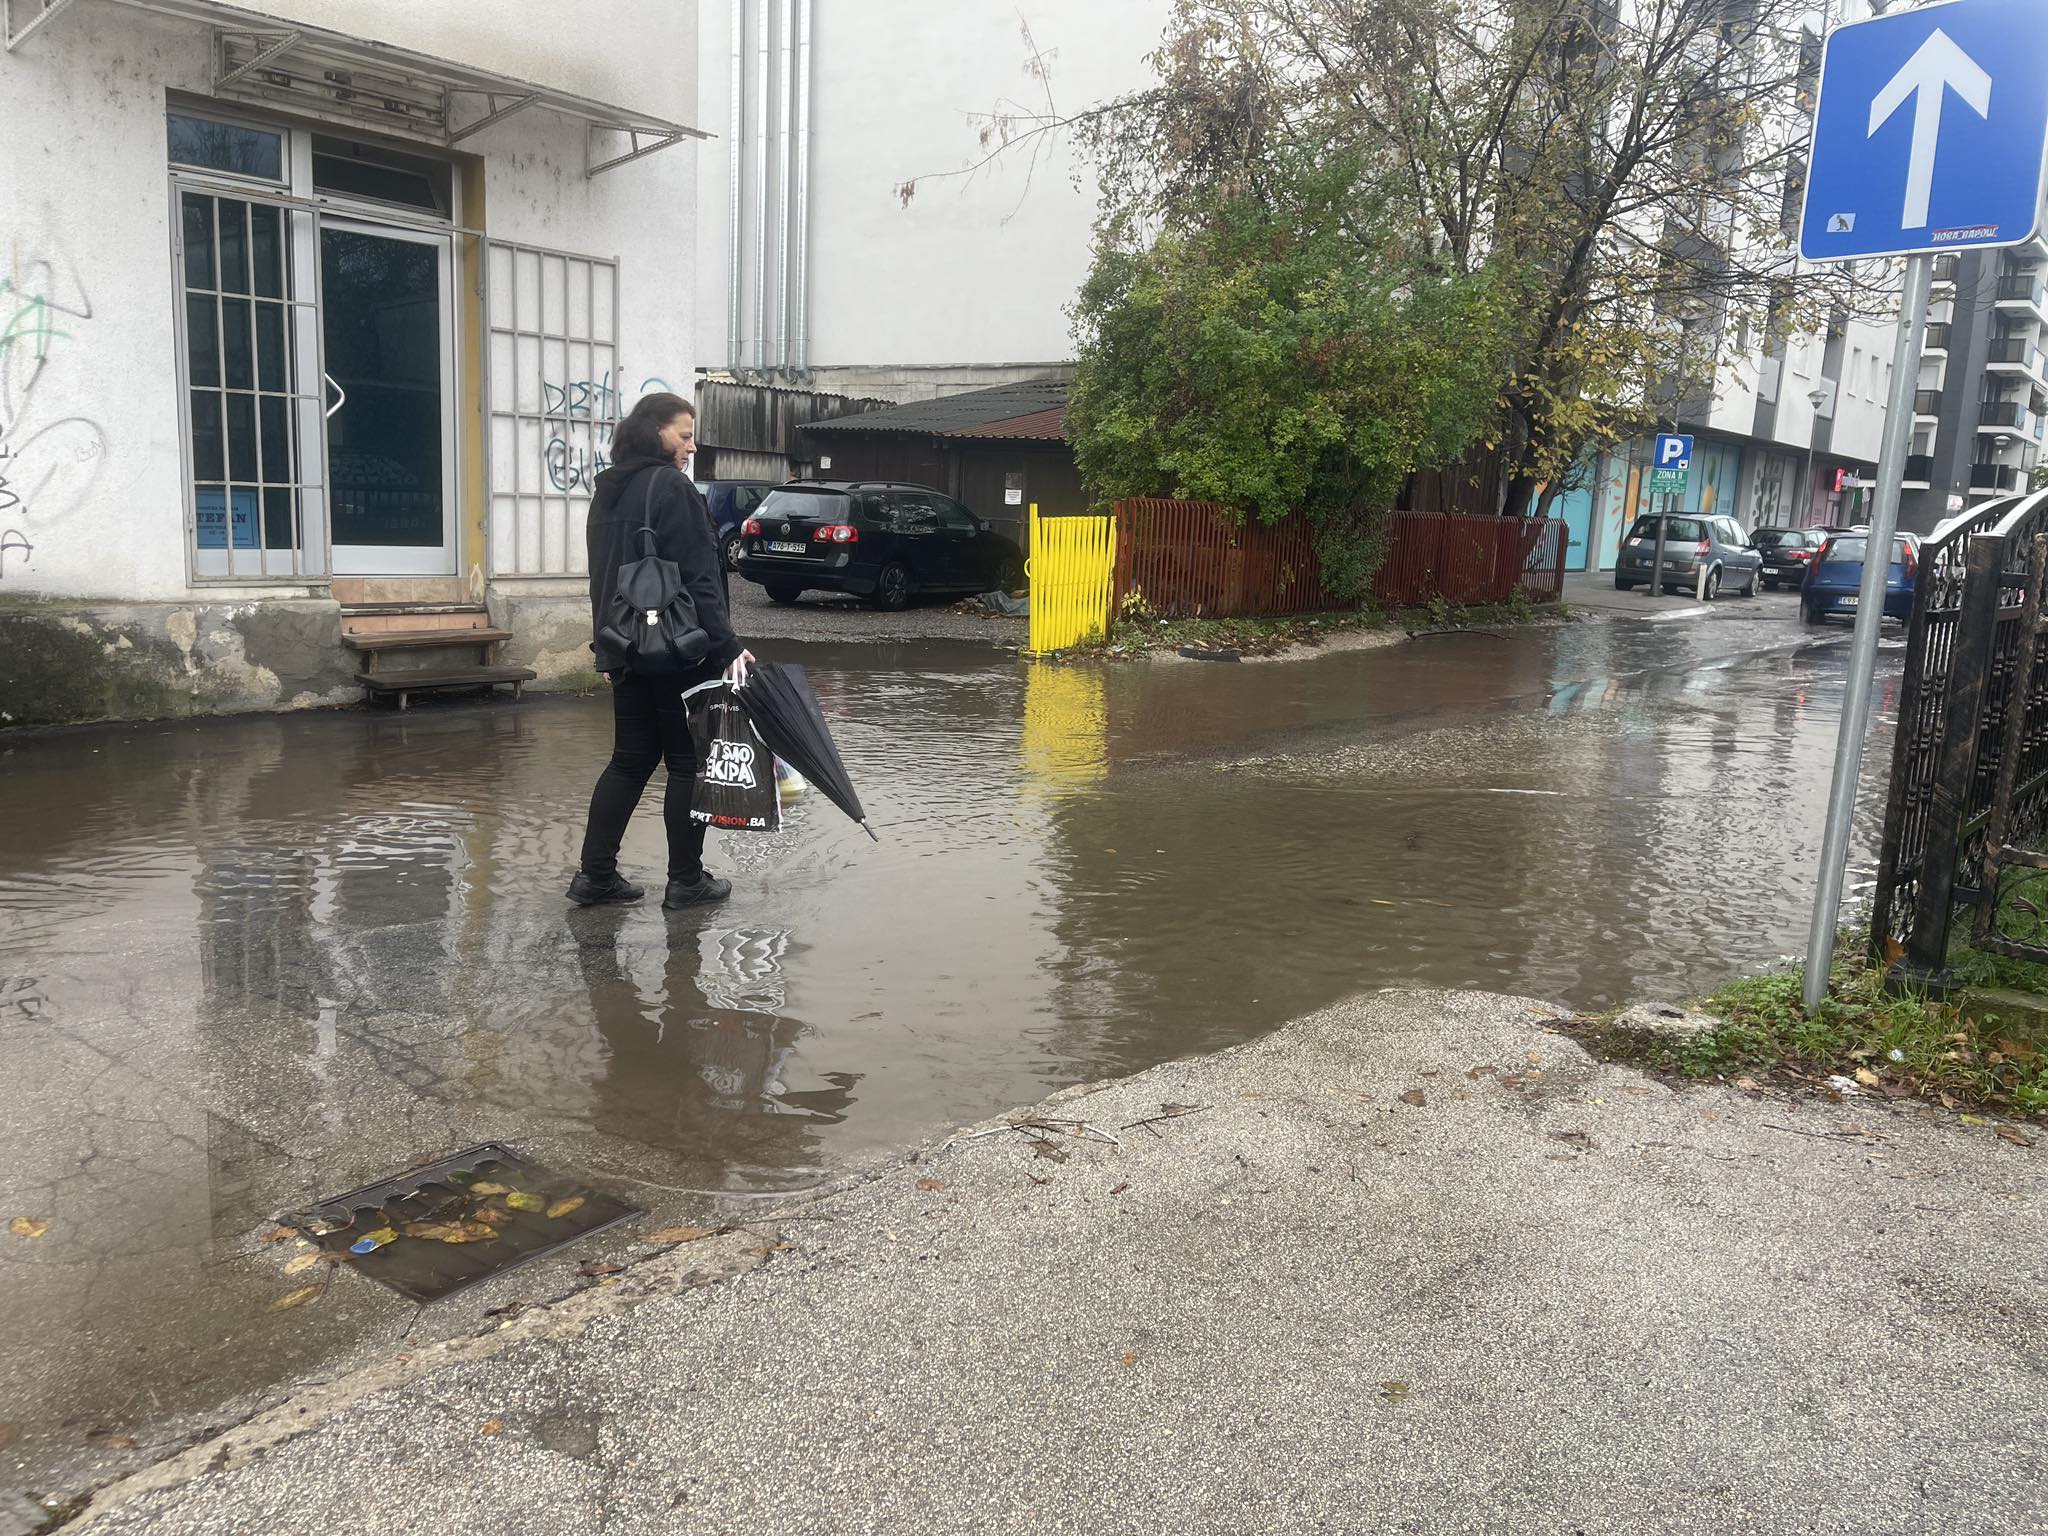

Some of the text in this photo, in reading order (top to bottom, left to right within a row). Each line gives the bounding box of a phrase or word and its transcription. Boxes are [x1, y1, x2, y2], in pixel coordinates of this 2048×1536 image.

[1662, 438, 1684, 464] P
[1657, 470, 1676, 480] ZONA
[196, 512, 247, 524] TEFN
[721, 744, 751, 764] SMO
[706, 758, 753, 784] EKIPA
